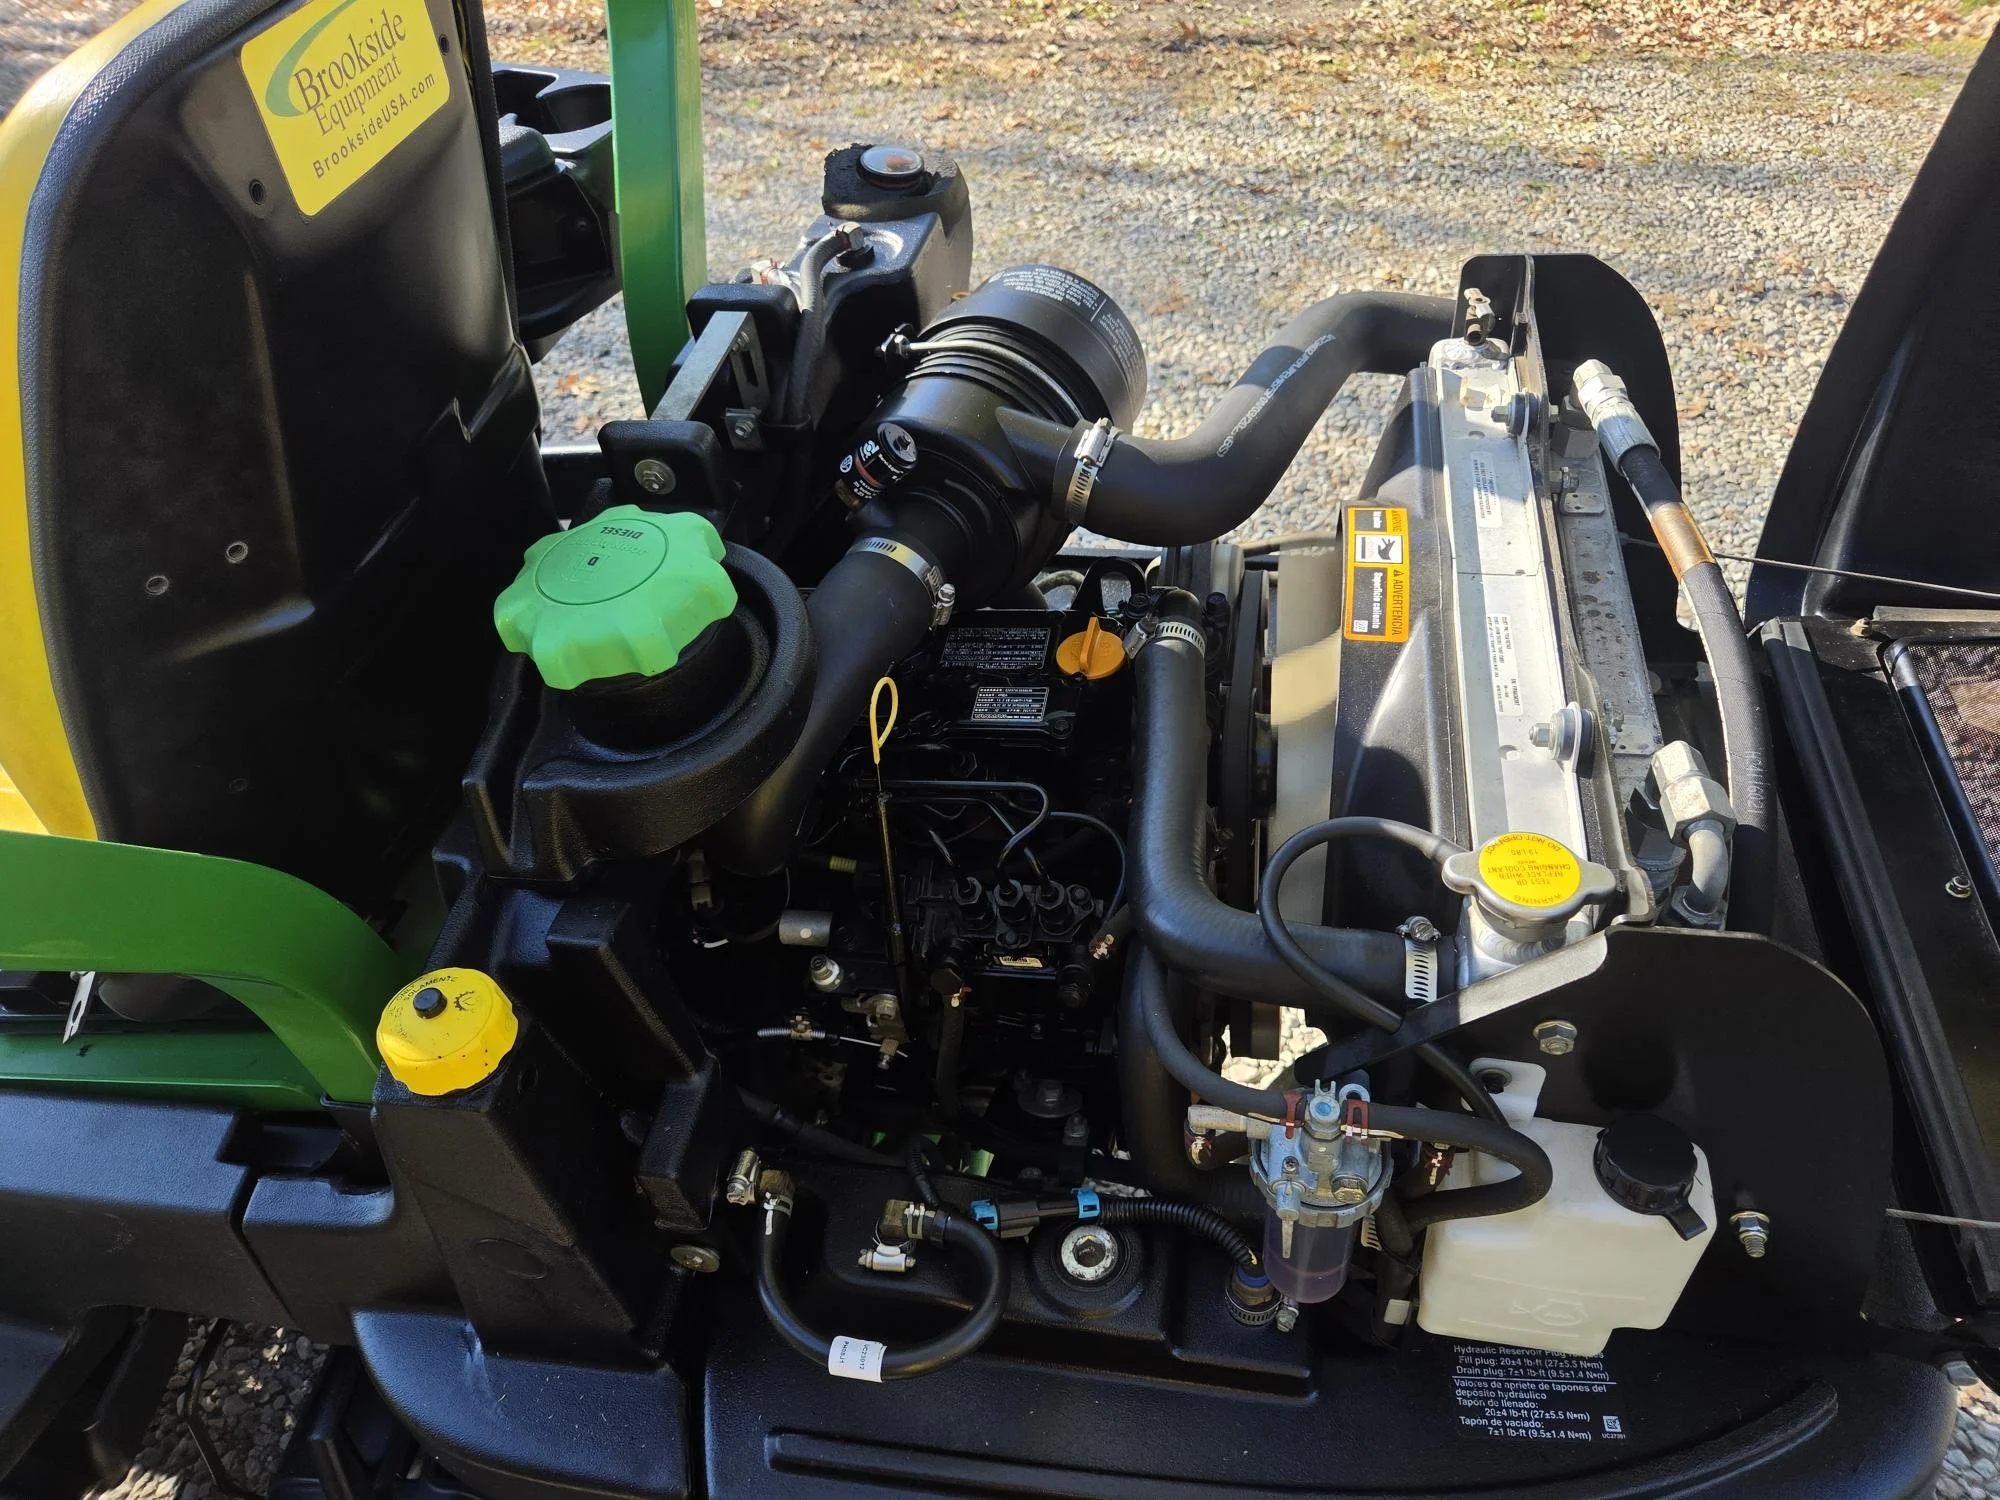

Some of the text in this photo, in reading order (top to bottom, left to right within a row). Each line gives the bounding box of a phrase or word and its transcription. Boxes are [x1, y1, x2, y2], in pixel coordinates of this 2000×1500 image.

[294, 8, 407, 112] Brookside
[314, 55, 402, 136] Equipment
[312, 72, 436, 179] BrooksideUSA.com
[600, 526, 644, 539] DIESEL
[587, 556, 600, 566] D
[1391, 580, 1403, 636] ADVERTENCIA
[1525, 835, 1546, 845] NOT
[1514, 892, 1562, 904] WARNING
[1453, 1344, 1497, 1355] Hydraulic
[1458, 1356, 1473, 1364] Fill
[1475, 1357, 1498, 1366] plug:
[1500, 1357, 1522, 1366] 20±4
[1523, 1358, 1542, 1367] lb-ft
[1545, 1359, 1578, 1369] (27±5.5
[1456, 1366, 1481, 1375] Drain
[1483, 1367, 1507, 1377] plug:
[1527, 1368, 1546, 1377] lb-ft
[1548, 1369, 1584, 1379] (9.5±1.4
[1454, 1378, 1607, 1392] Valores de apriete de tapones del
[1455, 1388, 1495, 1397] depósito
[1456, 1397, 1539, 1409] Tapón de llenado:
[1484, 1407, 1508, 1416] 20±4
[1509, 1409, 1528, 1418] lb-ft
[1530, 1410, 1564, 1420] (27±5.5
[1459, 1416, 1545, 1429] Tapón de vaciado:
[1487, 1427, 1504, 1436] 7±1
[1506, 1428, 1526, 1437] lb-ft
[1528, 1429, 1565, 1439] (9.5±1.4
